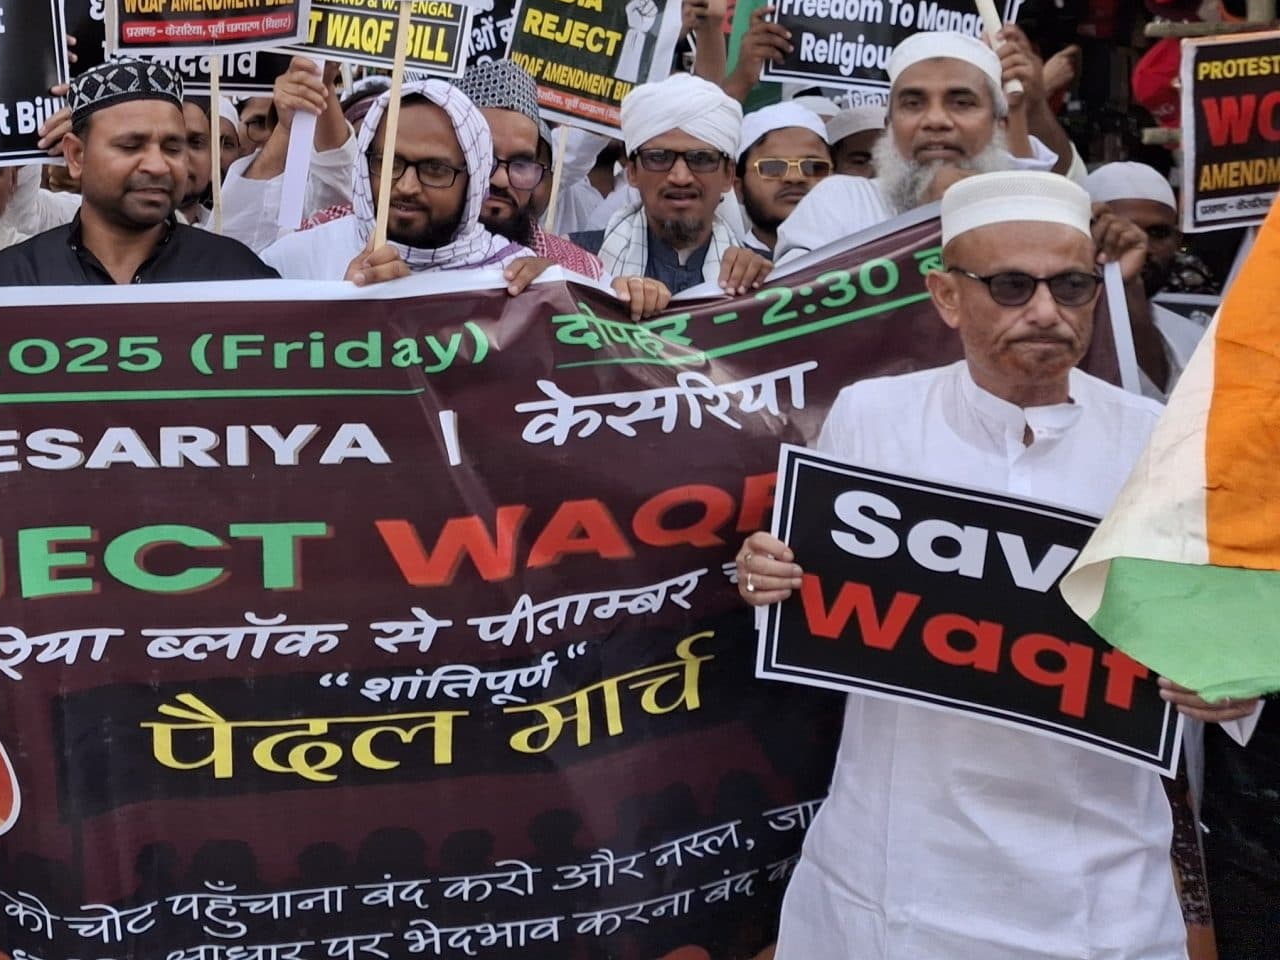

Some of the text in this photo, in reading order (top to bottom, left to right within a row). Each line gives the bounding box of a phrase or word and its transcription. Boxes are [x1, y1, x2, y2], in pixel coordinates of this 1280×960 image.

[326, 12, 394, 55] WAQF
[406, 23, 448, 63] BILL
[411, 1, 454, 18] ENGAL
[523, 8, 622, 57] REJECT
[542, 62, 612, 99] AMENDMENT
[800, 33, 893, 77] Religiou
[1198, 55, 1280, 81] PROTEST
[190, 321, 490, 375] (Friday)
[756, 256, 902, 326] 2:30
[514, 359, 819, 447] केसरिया
[829, 490, 1079, 595] Sav
[141, 611, 348, 662] ब्लॉक
[369, 606, 455, 654] से
[466, 566, 708, 648] पीताम्बर
[799, 572, 1149, 720] Waqf
[140, 630, 716, 782] पैदल मार्च
[0, 889, 61, 940] को
[63, 900, 159, 943] चोट
[166, 879, 348, 939] पहुँचाना
[355, 873, 432, 910] बंद
[438, 859, 543, 902] करो
[552, 847, 646, 890] और
[650, 818, 756, 868] नस्ल,
[403, 918, 566, 957] भेदभाव
[571, 888, 697, 939] करना
[700, 867, 760, 902] बंद
